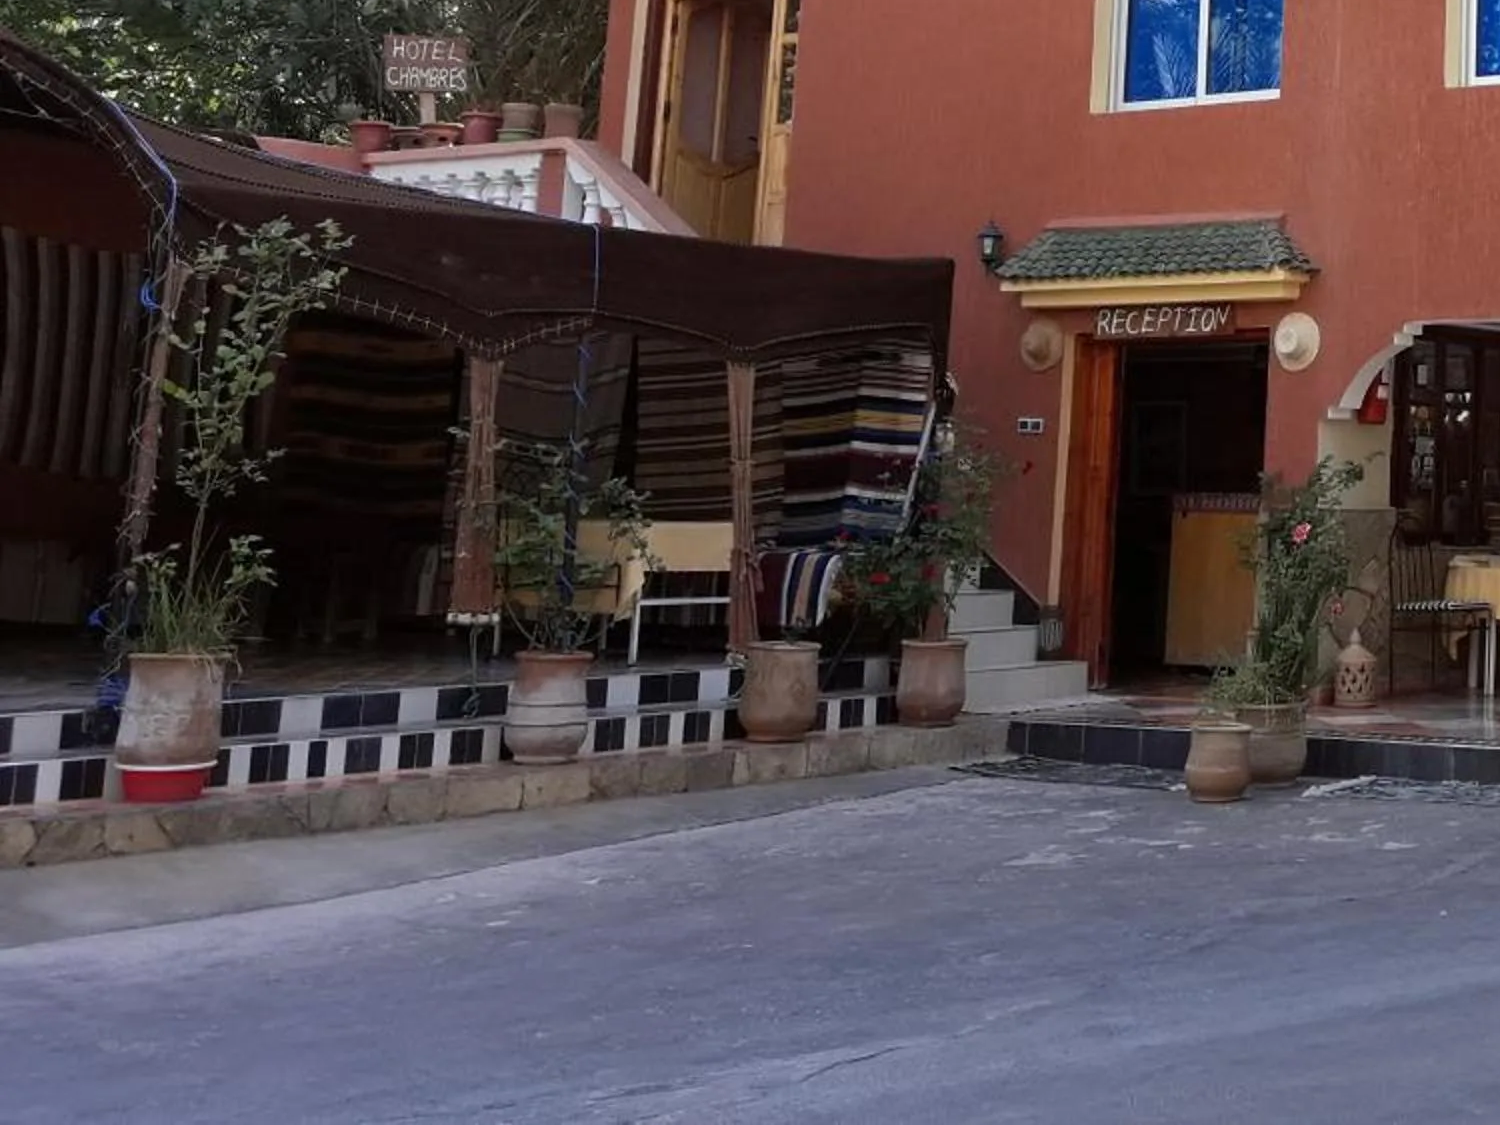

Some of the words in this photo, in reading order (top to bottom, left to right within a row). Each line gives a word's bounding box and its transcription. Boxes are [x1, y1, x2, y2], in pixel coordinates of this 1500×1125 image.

[392, 38, 463, 63] HOTEL
[386, 65, 467, 91] CHAMBRES
[1097, 305, 1231, 336] RECEPTION
